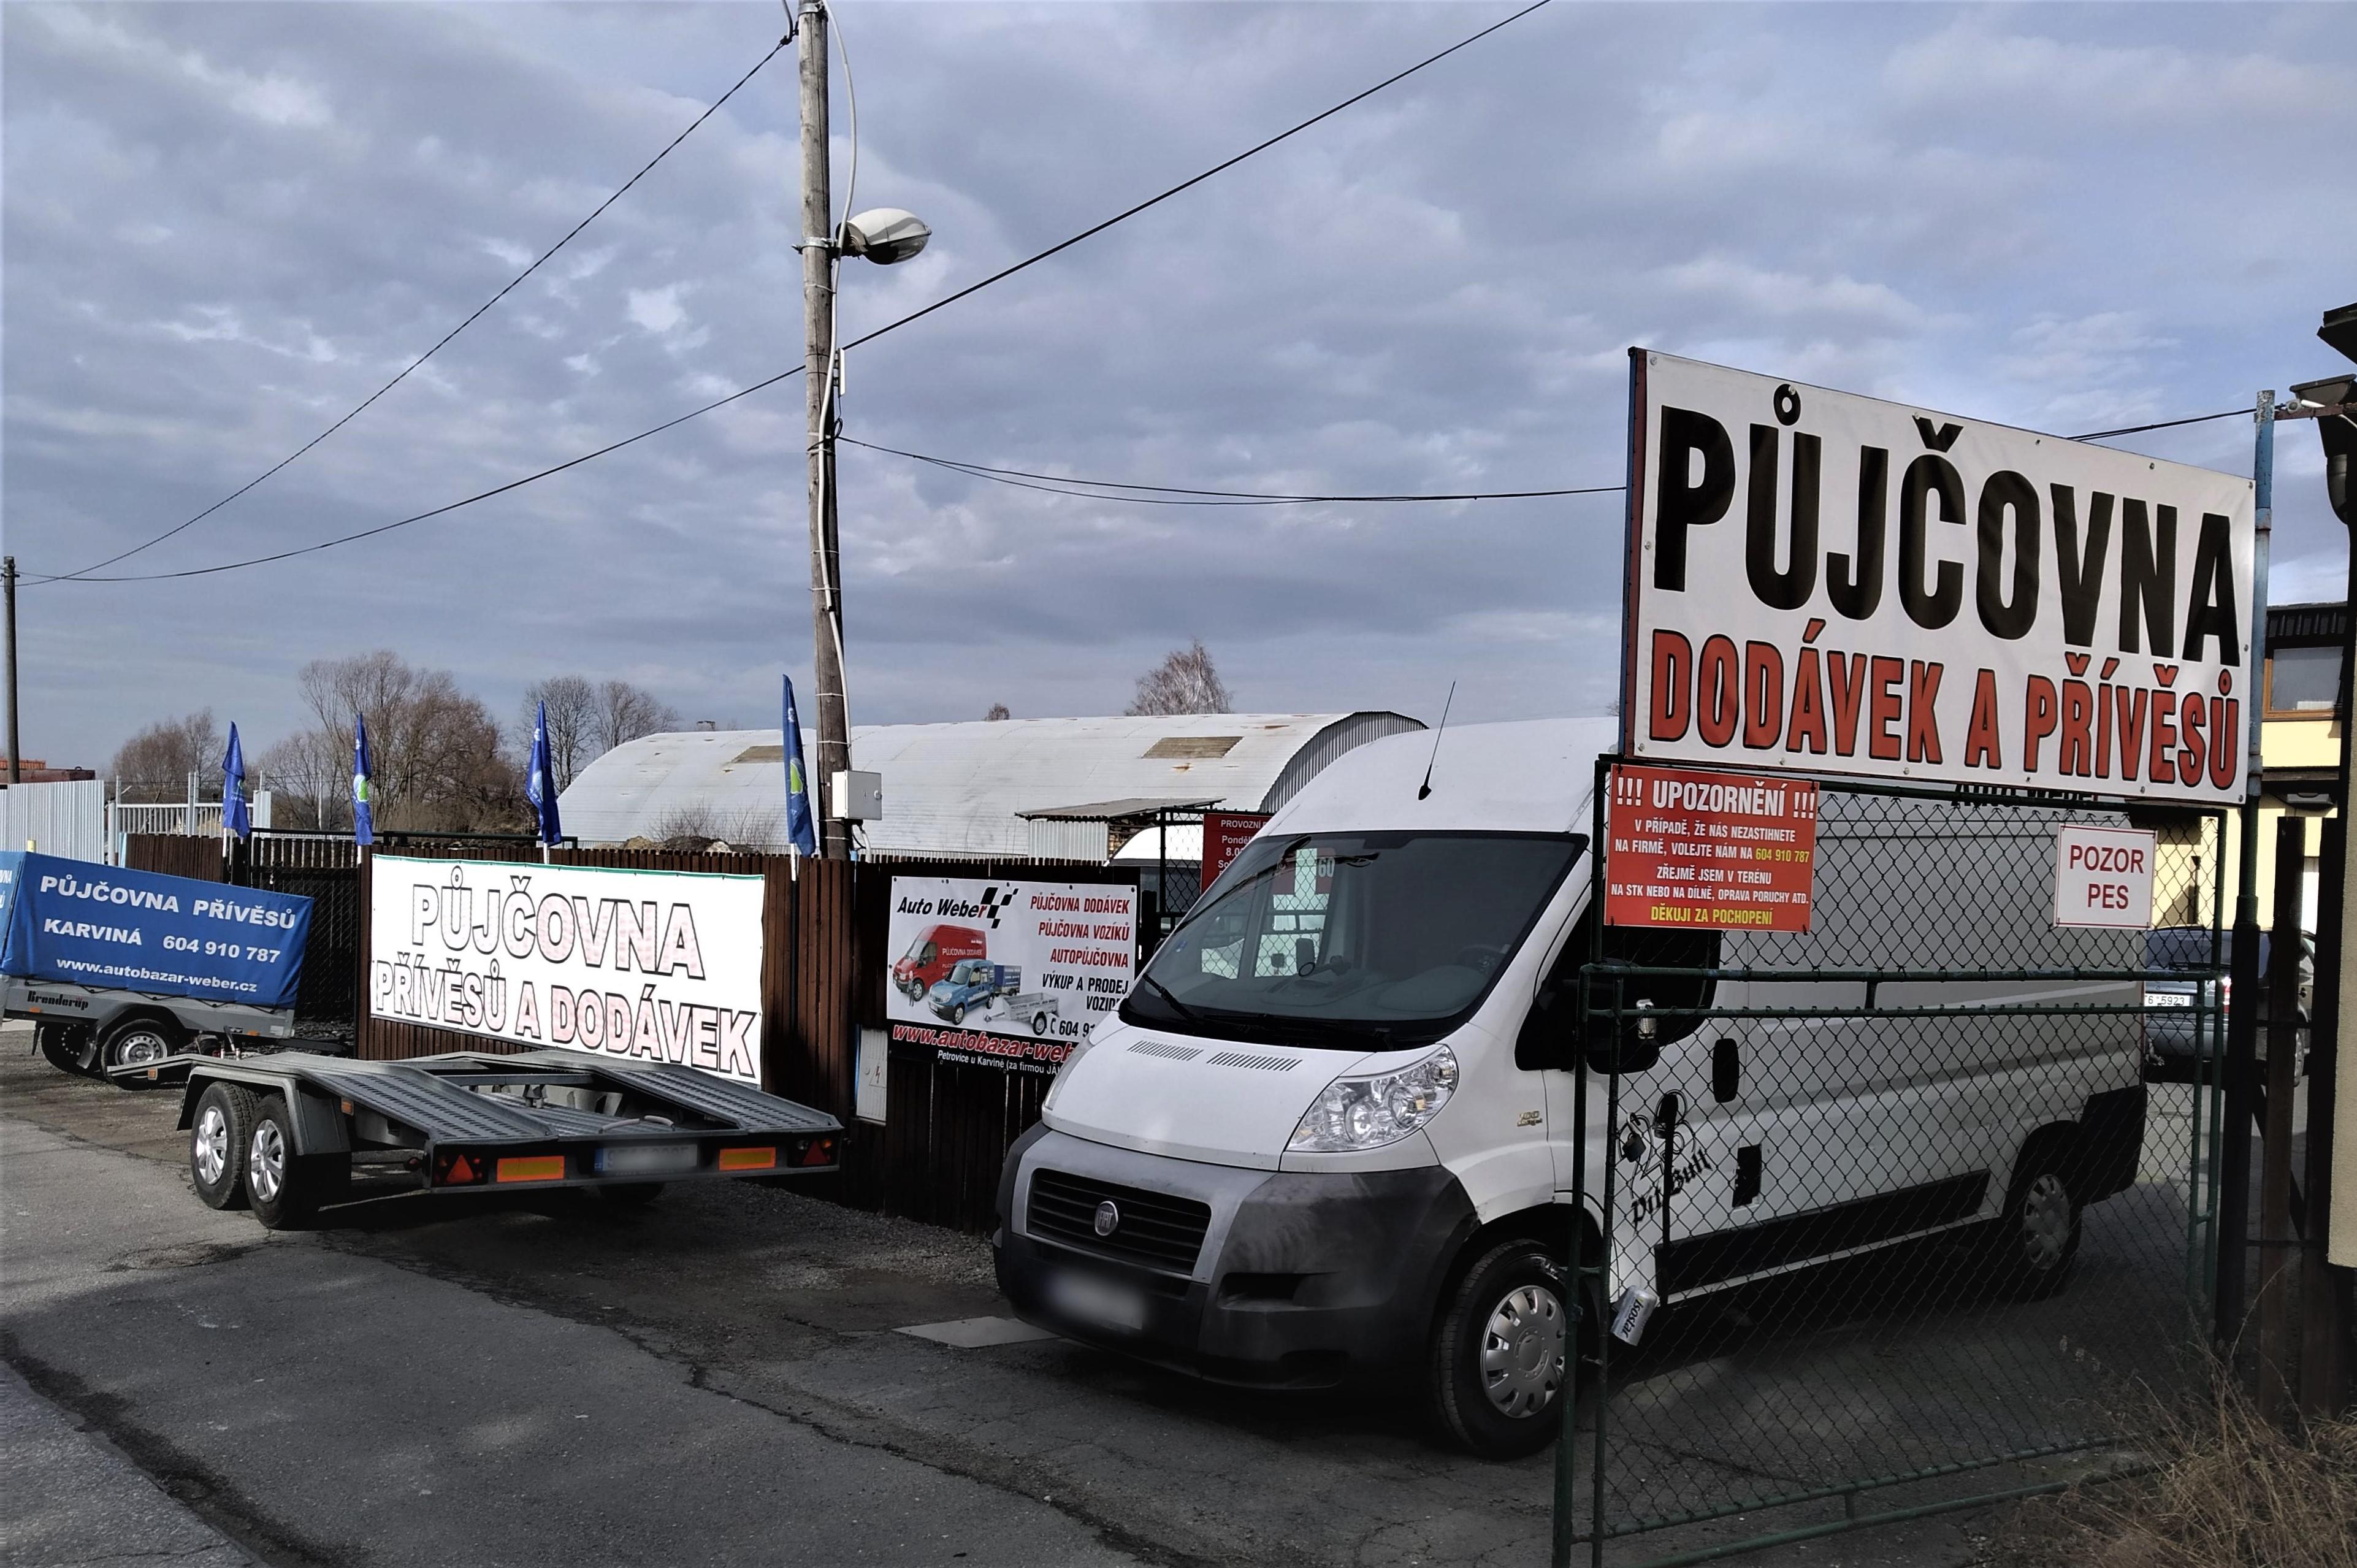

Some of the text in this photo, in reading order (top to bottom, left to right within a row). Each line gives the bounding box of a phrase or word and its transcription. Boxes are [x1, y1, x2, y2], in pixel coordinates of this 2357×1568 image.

[1653, 383, 2241, 667] PŮJČOVNA
[1649, 618, 2239, 790] DODÁVEK A PŘÍVĚSŮ
[1616, 776, 1816, 819] !!! UPOZORNĚNÍ !!!
[1221, 820, 1261, 828] PROVOZNÍ
[1635, 817, 1795, 842] V PŘÍPADĚ, ŽE NÁS NEZASTIHNETE
[1615, 838, 1810, 863] NA FIRMĚ, VOLEJTE NÁM NA 604 910 787
[2069, 845, 2144, 874] POZOR
[1218, 860, 1232, 868] So
[1657, 862, 1772, 884] ZŘEJMĚ JSEM V TERÉNU
[40, 874, 179, 913] PŮJČOVNA
[193, 900, 296, 930] PŘÍVĚSŮ
[1030, 892, 1130, 914] PŮJČOVNA DODÁVEK
[1611, 884, 1809, 904] NA STK NEBO NA DÍLNĚ, OPRAVA PORUCHY ATD.
[2087, 883, 2130, 910] PES
[897, 897, 987, 918] Auto Weber
[1651, 903, 1773, 925] DĚKUJI ZA POCHOPENÍ
[411, 865, 706, 981] PŮJČOVNA
[1038, 918, 1130, 941] PŮJČOVNA VOZÍKŮ
[44, 919, 280, 964] KARVINÁ 604 910 787
[1050, 946, 1128, 968] AUTOPŮJČOVNA
[56, 958, 257, 993] www.autobazar-weber.cz
[1042, 970, 1129, 995] VÝKUP A PRODEJ
[27, 990, 89, 1011] Brenderup
[376, 951, 757, 1078] PŘÍVĚSŮ A DODÁVEK
[1059, 1020, 1079, 1036] 604
[938, 1050, 969, 1063] Petrovice
[977, 1056, 1004, 1068] Karviné
[1006, 1059, 1018, 1071] (za
[1019, 1061, 1044, 1074] firmou
[1098, 1210, 1114, 1229] FIAT
[1622, 1298, 1644, 1338] isostar
